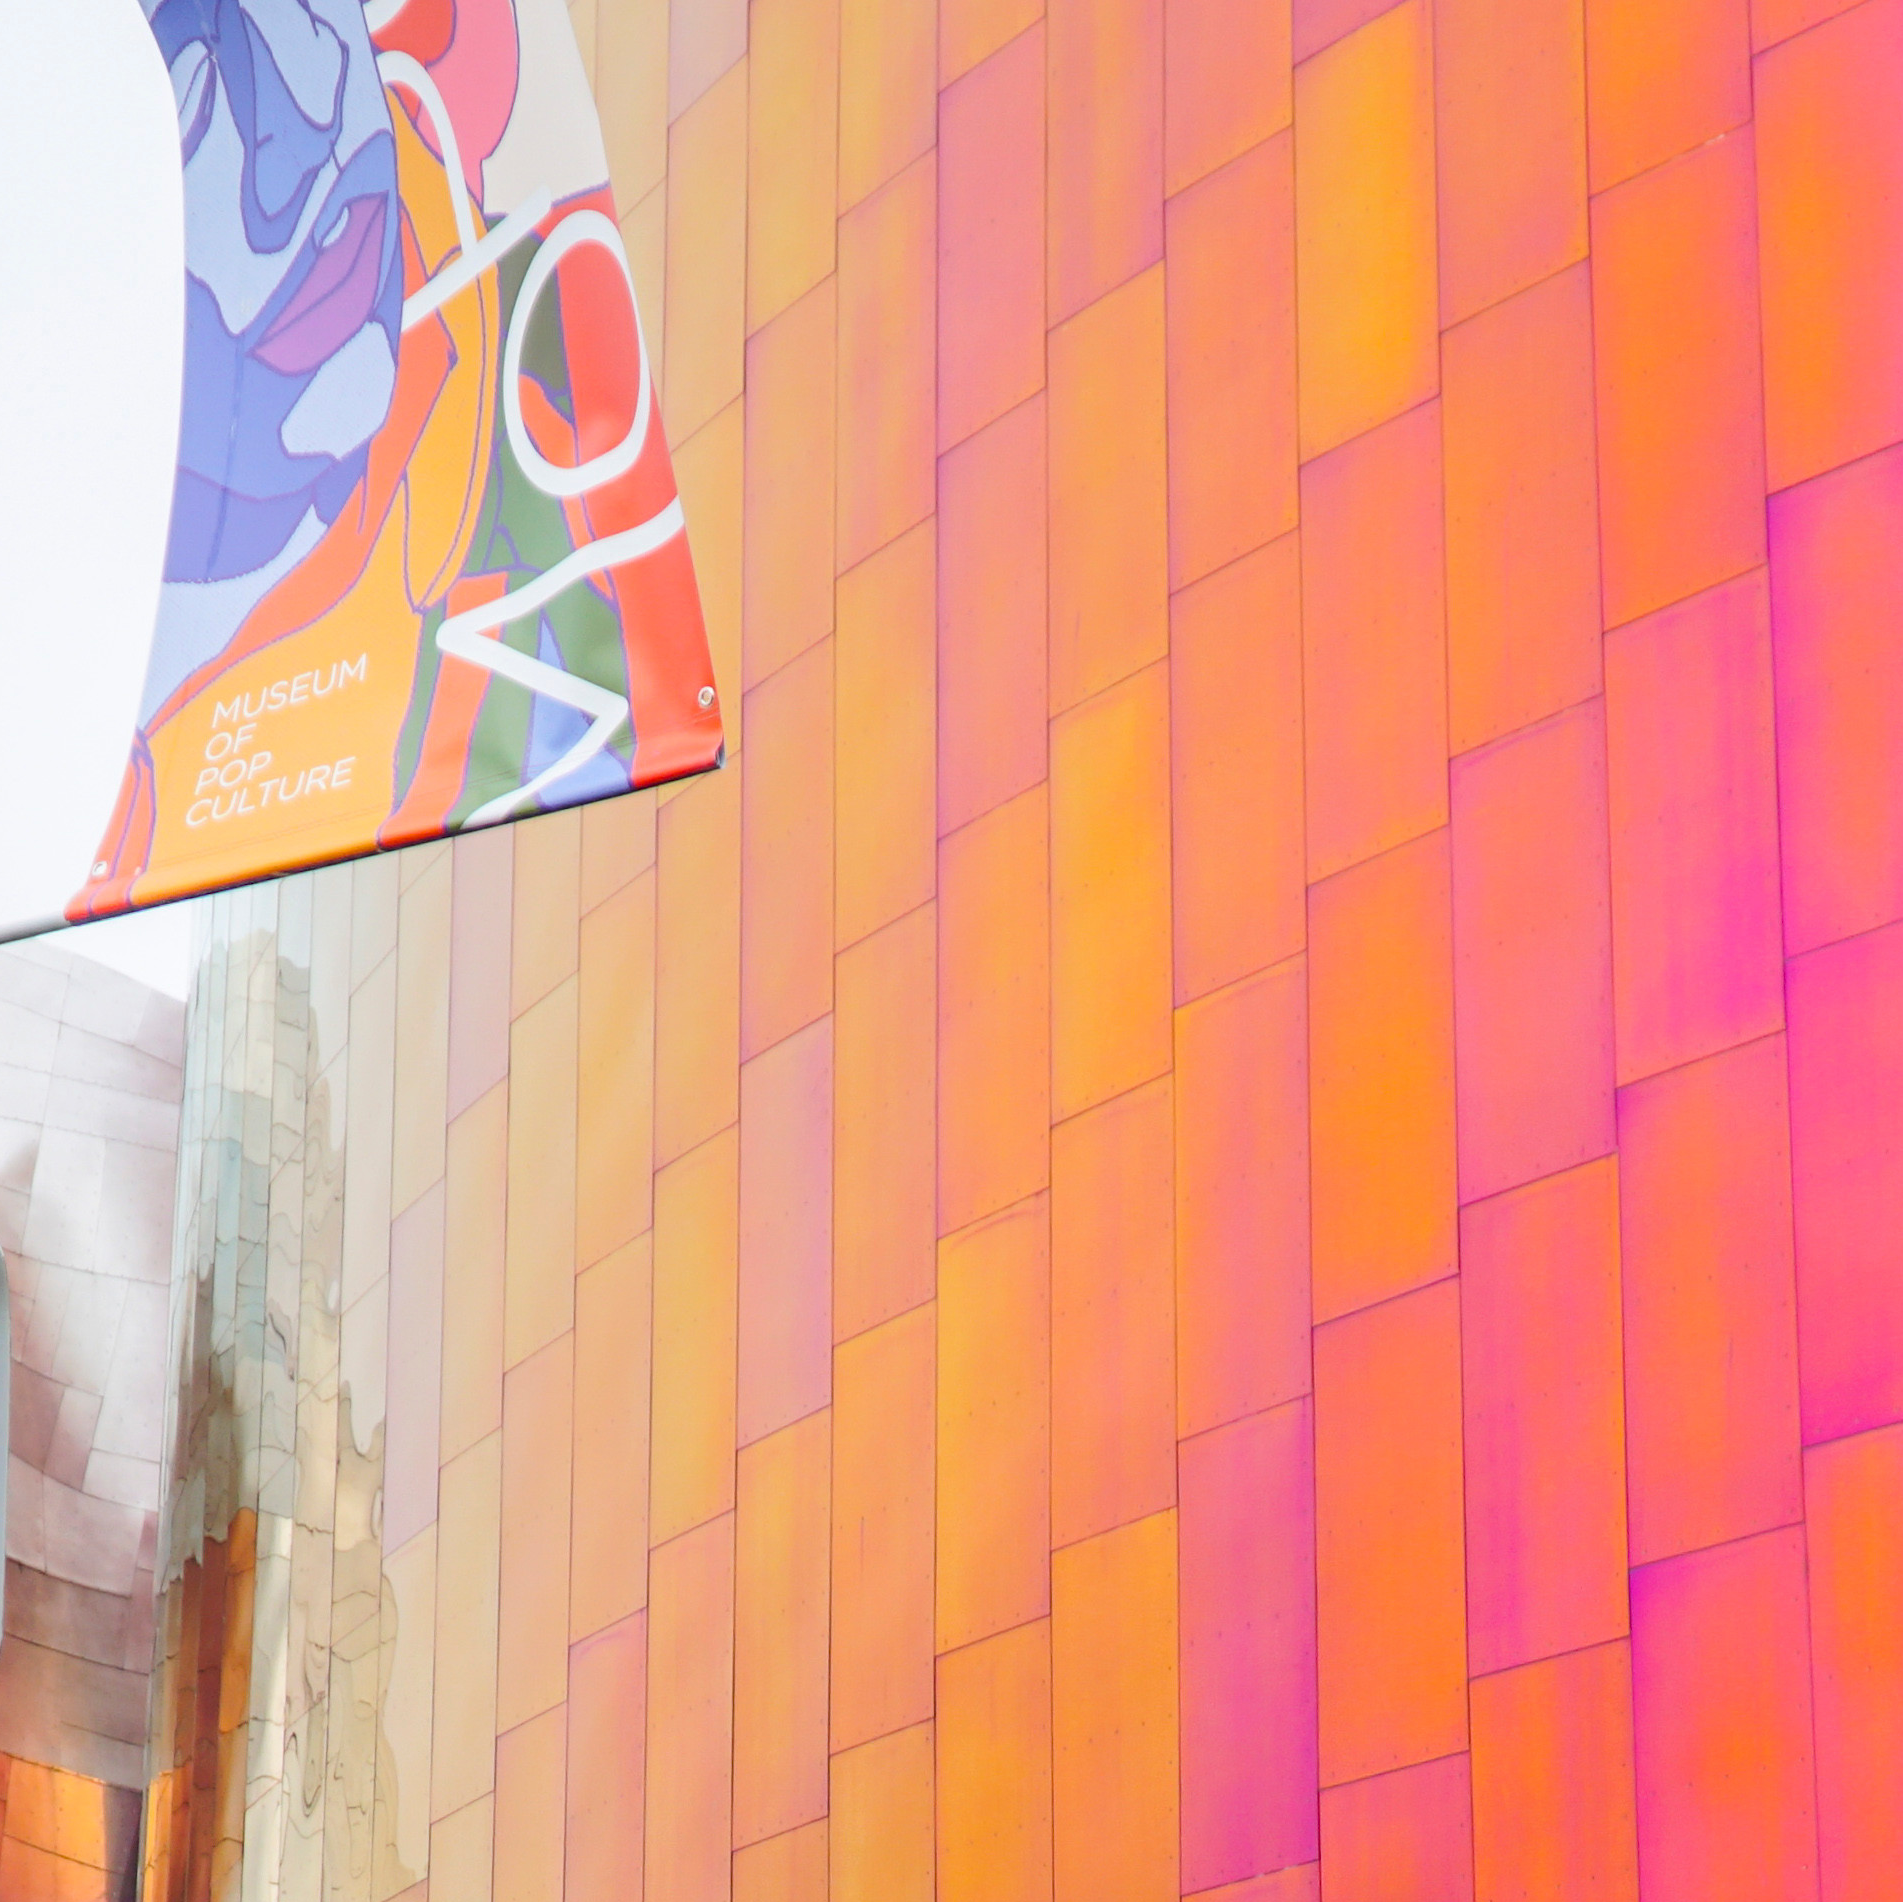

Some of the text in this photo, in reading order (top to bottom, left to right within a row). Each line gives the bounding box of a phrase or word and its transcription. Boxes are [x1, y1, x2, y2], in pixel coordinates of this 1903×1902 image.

[211, 652, 367, 728] MUSEUM
[205, 722, 257, 760] OF
[185, 755, 357, 826] CULTURE
[194, 750, 272, 796] POP
